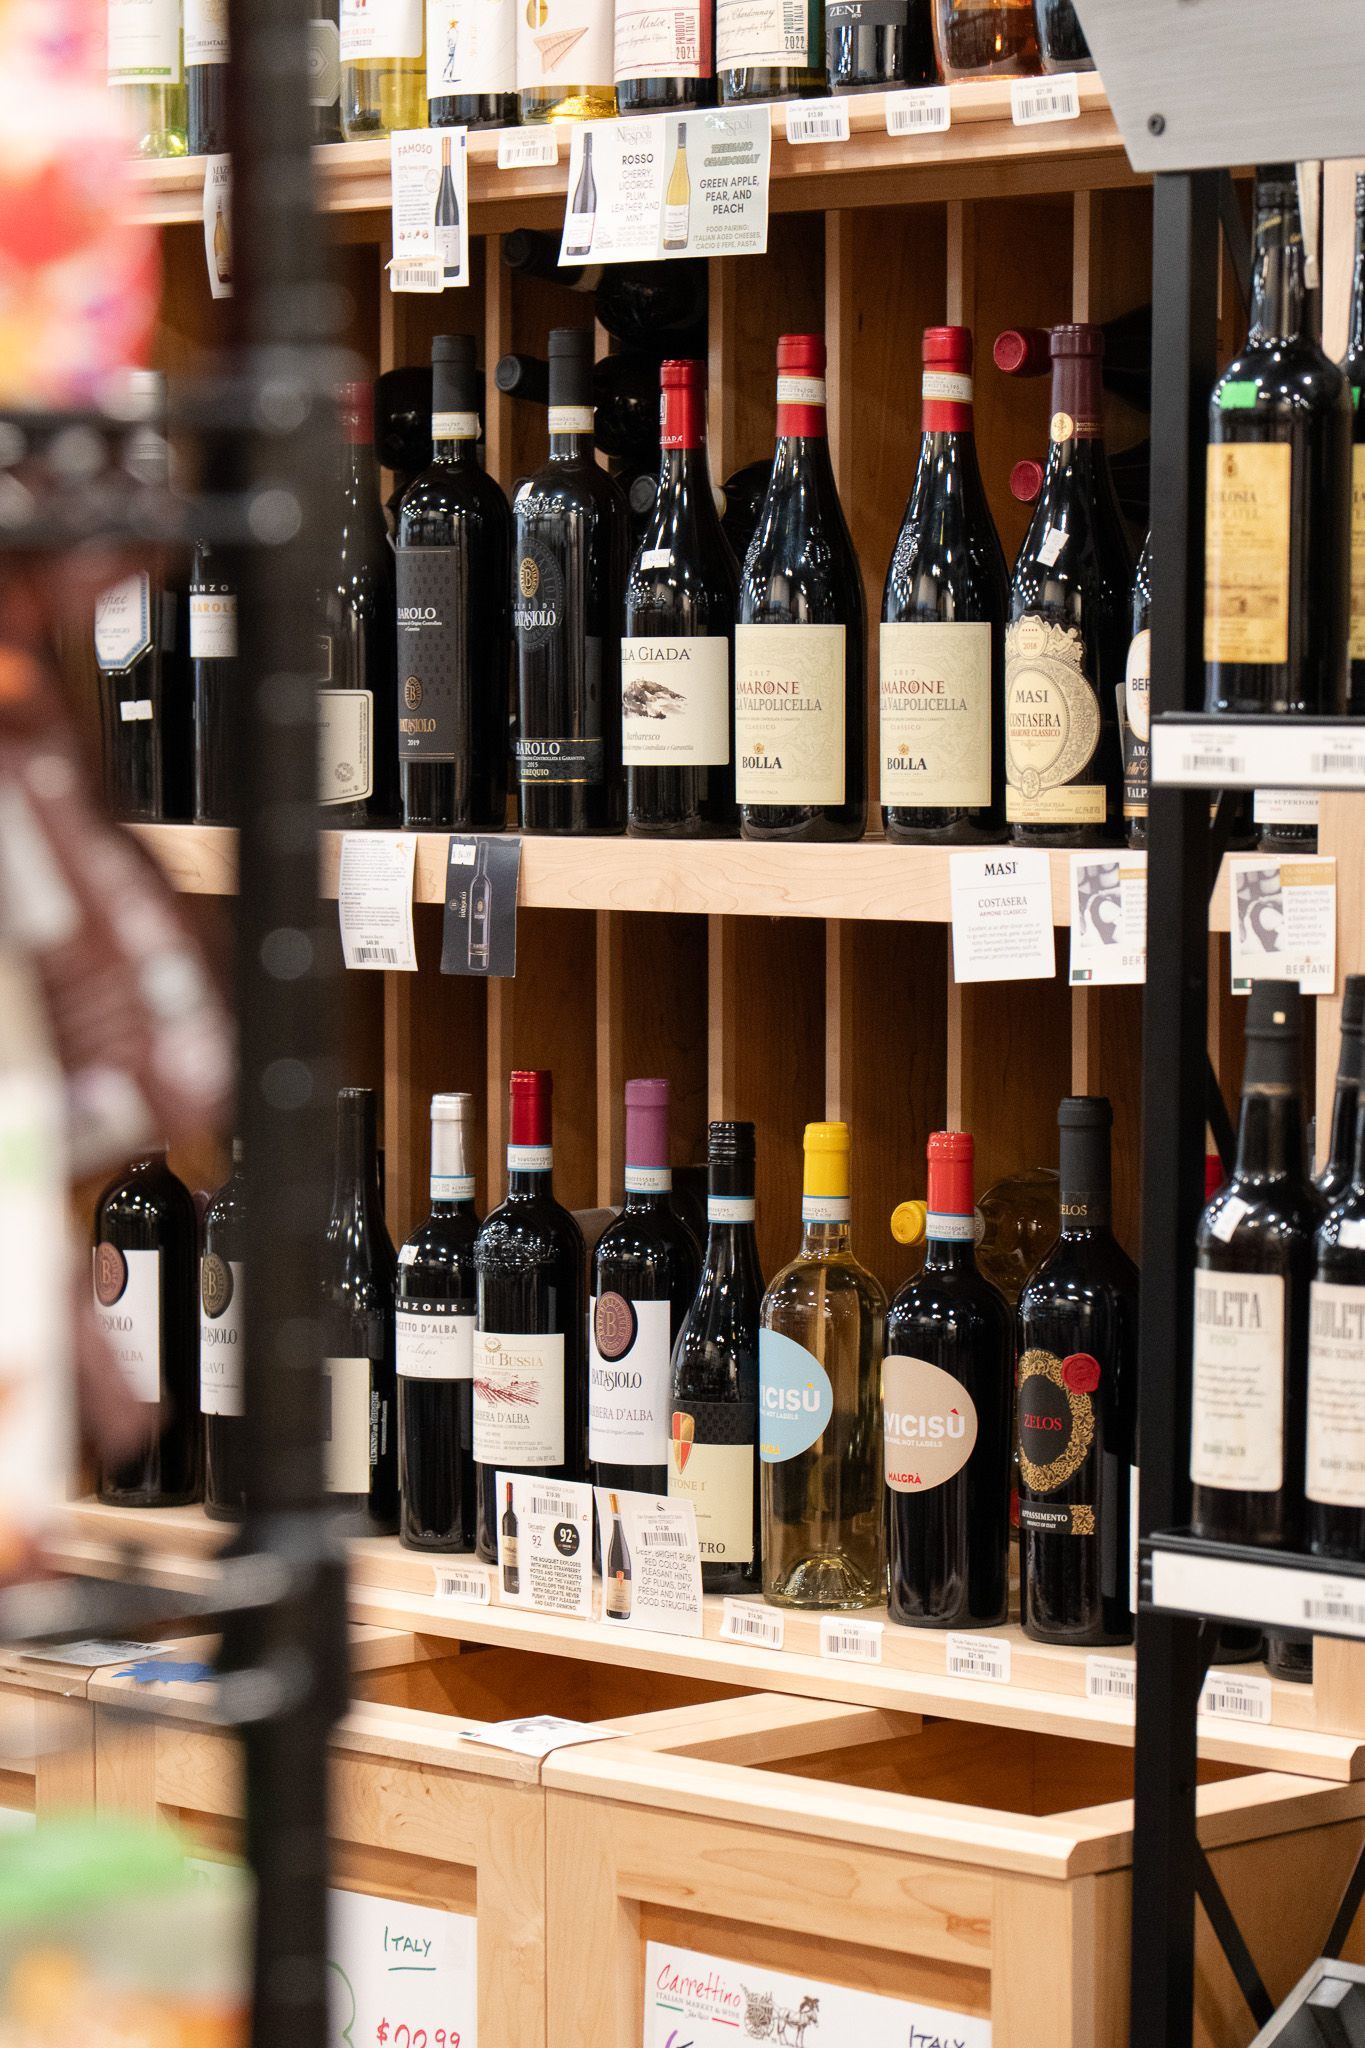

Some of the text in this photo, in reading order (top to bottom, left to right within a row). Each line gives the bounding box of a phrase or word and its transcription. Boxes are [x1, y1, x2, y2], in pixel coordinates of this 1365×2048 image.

[829, 4, 863, 17] ZENI
[785, 36, 805, 50] 2022
[676, 46, 696, 60] 2021
[398, 143, 433, 156] FAMOSO
[711, 141, 755, 154] TREBBIANO
[622, 153, 655, 165] ROSSO
[703, 153, 761, 168] CHARDONNAY
[699, 175, 760, 189] GREEN APPLE,
[705, 189, 753, 202] PEAR, AND
[712, 203, 745, 215] PEACH
[625, 213, 643, 222] MINT
[706, 225, 723, 233] FOOD
[638, 646, 691, 661] GIADA
[1015, 690, 1049, 703] MASI
[742, 757, 783, 769] BOLLA
[887, 757, 928, 770] BOLLA
[984, 861, 1017, 876] MASI
[977, 896, 1028, 908] COSTASERA
[1285, 964, 1330, 975] BERTANI
[616, 1408, 654, 1421] D'ALBA
[1023, 1414, 1063, 1431] ZELOS
[531, 1534, 542, 1546] 92
[559, 1527, 574, 1543] 92
[644, 1557, 658, 1567] RED
[530, 1573, 547, 1582] TYPICAL
[641, 1567, 693, 1582] PLEASANT HINTS
[641, 1577, 652, 1585] OF
[566, 1585, 582, 1593] PALATE
[637, 1586, 697, 1604] FRESH AND WITH A
[559, 1597, 581, 1605] PLEASANT
[636, 1595, 699, 1613] GOOD STRUCTURE
[384, 1925, 433, 1957] ITALY
[656, 1963, 742, 2008] Carrettino
[656, 1991, 685, 2004] ITALIAN
[722, 2009, 741, 2020] WINE
